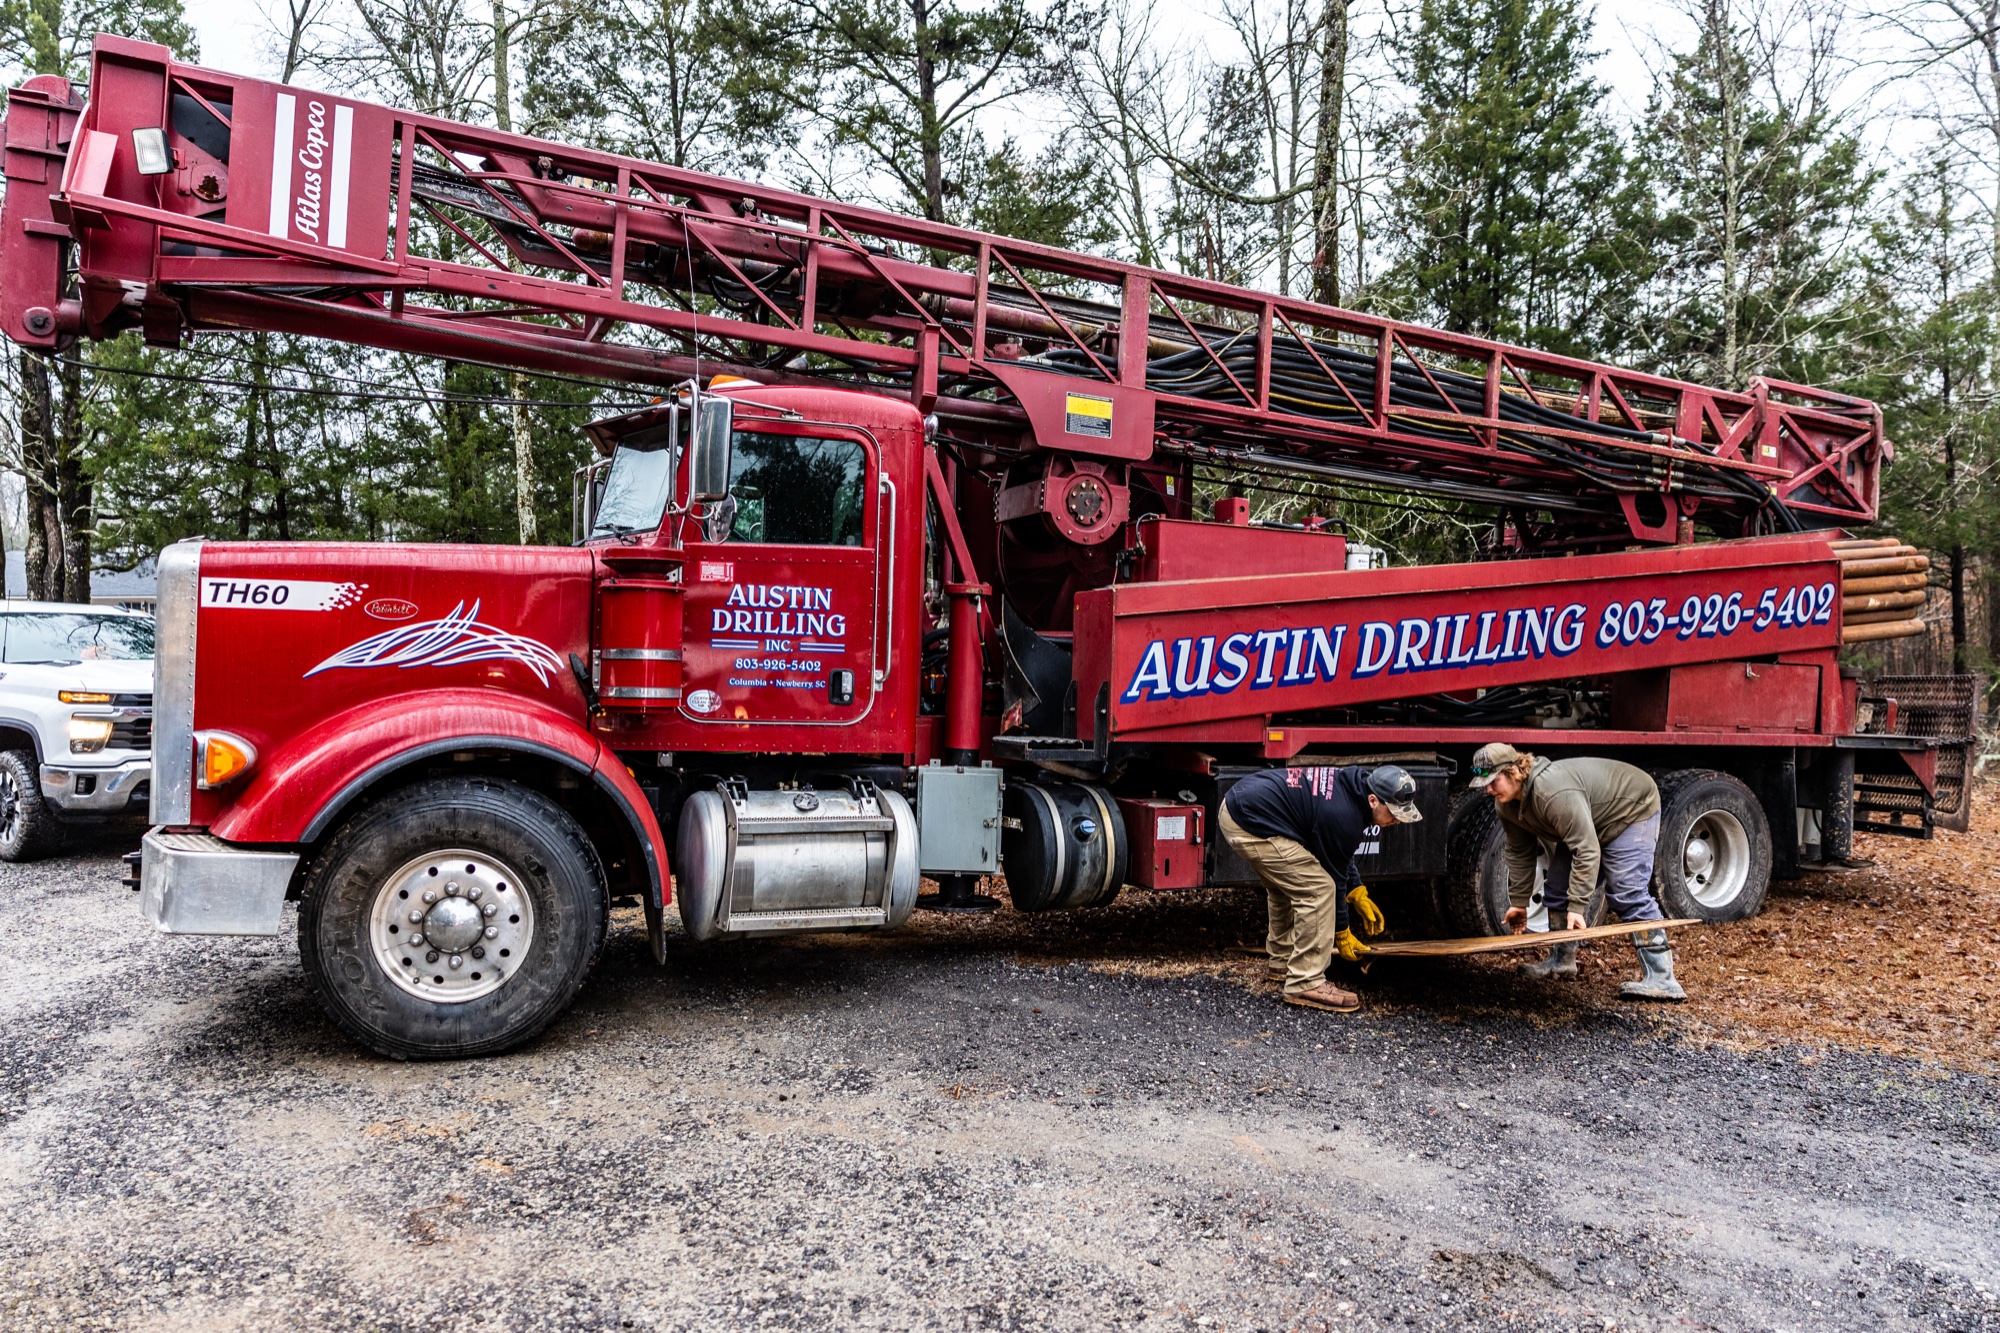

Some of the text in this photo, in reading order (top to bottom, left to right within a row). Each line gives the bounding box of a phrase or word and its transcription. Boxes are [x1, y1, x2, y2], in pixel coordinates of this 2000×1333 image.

[295, 100, 329, 243] Atlas Copco
[208, 581, 290, 605] TH60
[726, 583, 833, 610] AUSTIN
[711, 608, 847, 637] DRILLING
[764, 638, 794, 653] INC.
[1121, 582, 1836, 703] AUSTIN DRILLING 803-926-5402
[734, 657, 822, 672] 803-926-5402
[728, 677, 767, 687] Columbia
[815, 680, 826, 689] SC
